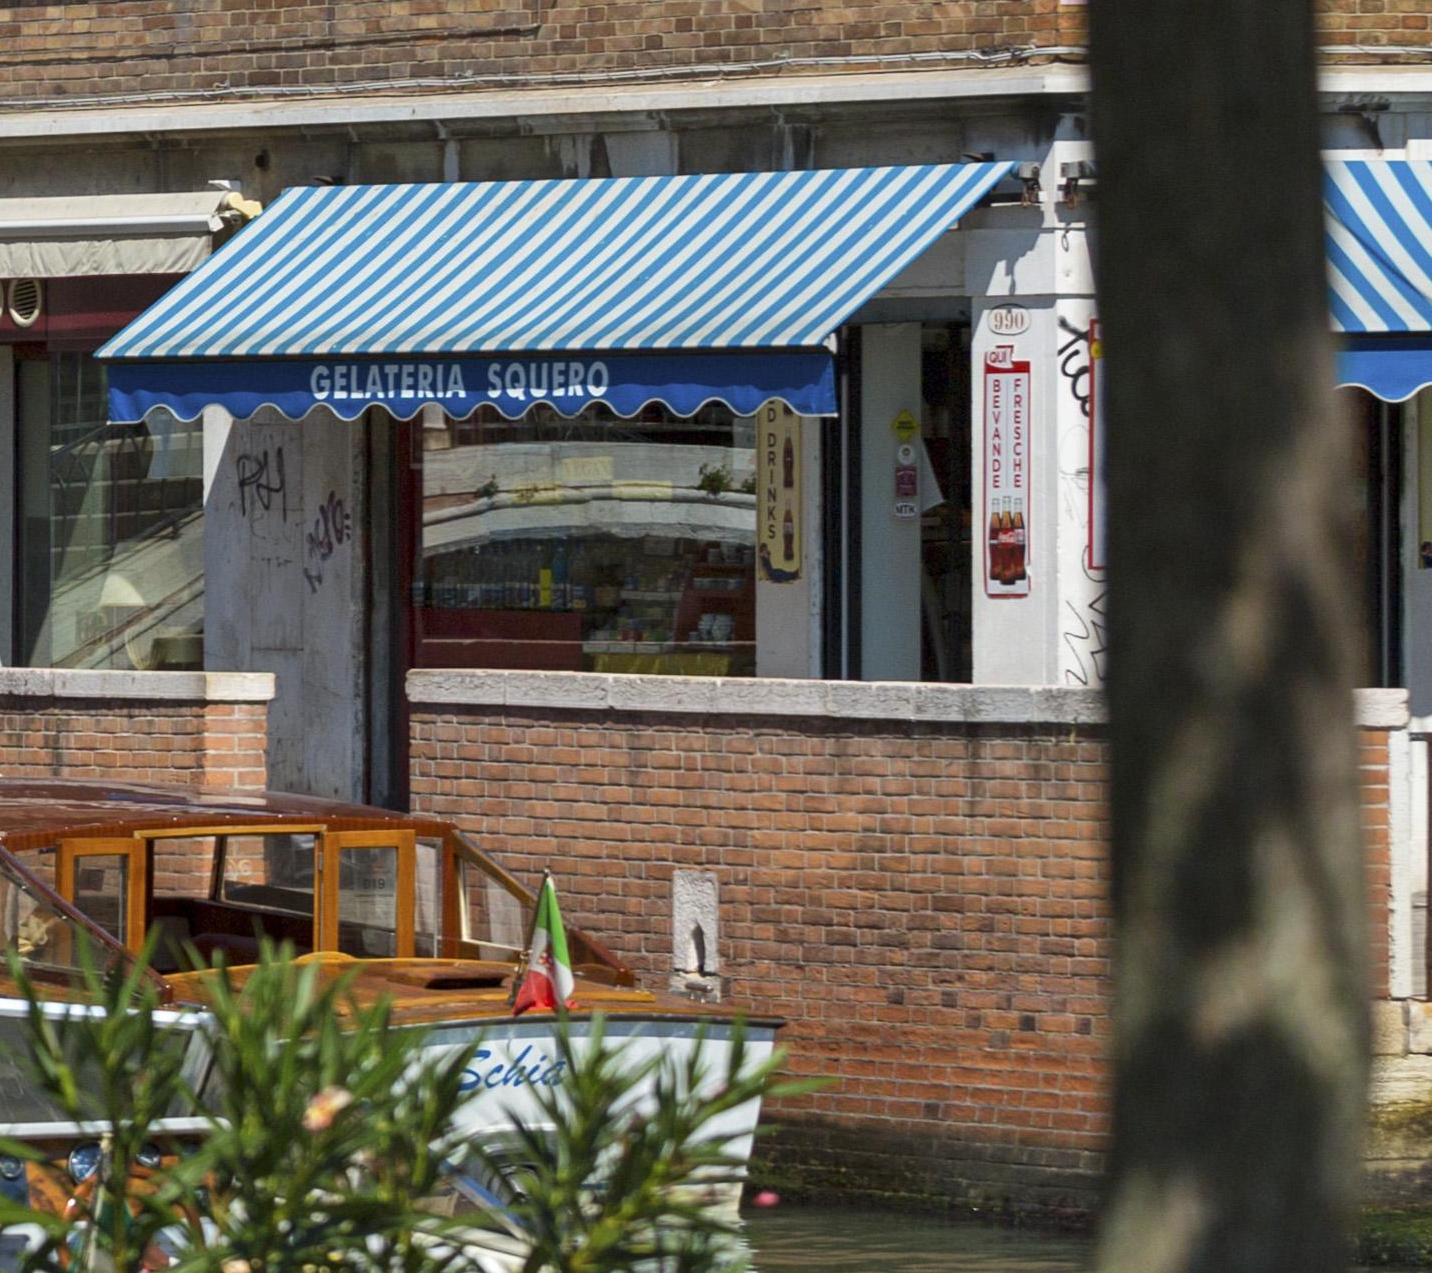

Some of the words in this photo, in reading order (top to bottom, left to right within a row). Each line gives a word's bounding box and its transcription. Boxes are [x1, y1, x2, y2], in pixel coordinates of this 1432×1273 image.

[989, 350, 1007, 364] QUI
[993, 312, 1025, 330] 990
[310, 363, 467, 400] GELATERIA
[486, 360, 610, 401] SQUERO
[992, 379, 1002, 489] BEVANDE
[1013, 378, 1023, 488] FRESCHE
[767, 432, 778, 540] DRINKS
